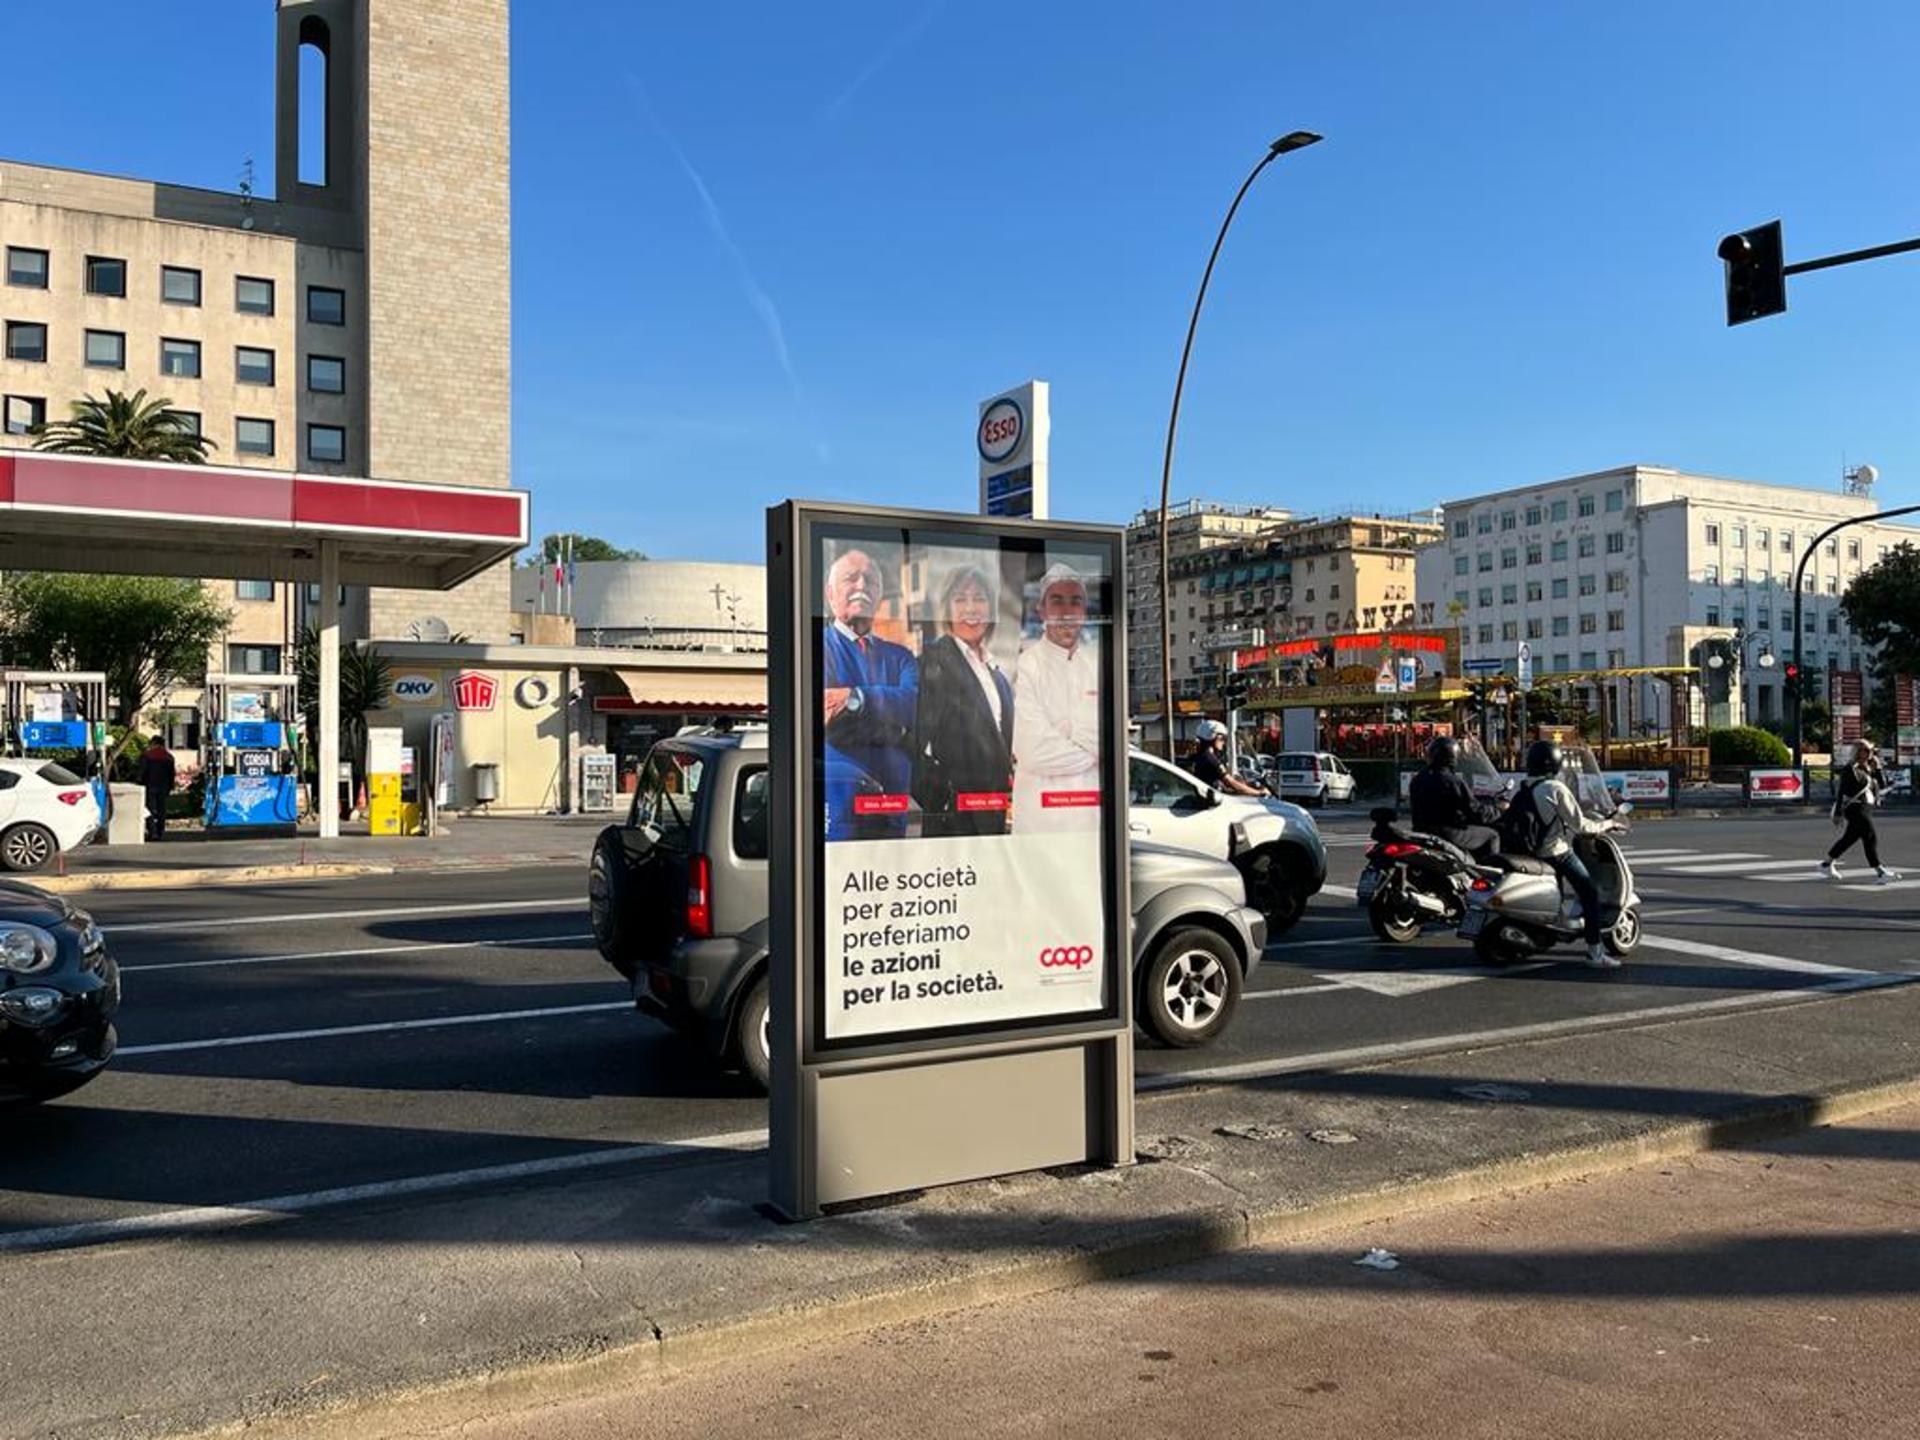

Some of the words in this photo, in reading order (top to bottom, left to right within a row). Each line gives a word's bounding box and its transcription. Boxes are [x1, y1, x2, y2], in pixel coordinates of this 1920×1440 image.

[1325, 602, 1435, 632] CANYON
[395, 681, 435, 694] DKV
[1404, 669, 1412, 680] P
[458, 682, 494, 709] UTA
[31, 729, 40, 740] 3
[230, 729, 236, 739] 1
[843, 870, 889, 893] Alle
[896, 865, 977, 890] società
[843, 903, 883, 925] per
[890, 893, 957, 918] azioni
[843, 923, 970, 953] preferiamo
[843, 956, 864, 977] le
[871, 949, 940, 975] azioni
[1040, 945, 1093, 970] coop
[843, 986, 885, 1010] per
[891, 980, 910, 1001] la
[916, 970, 1003, 998] società.
